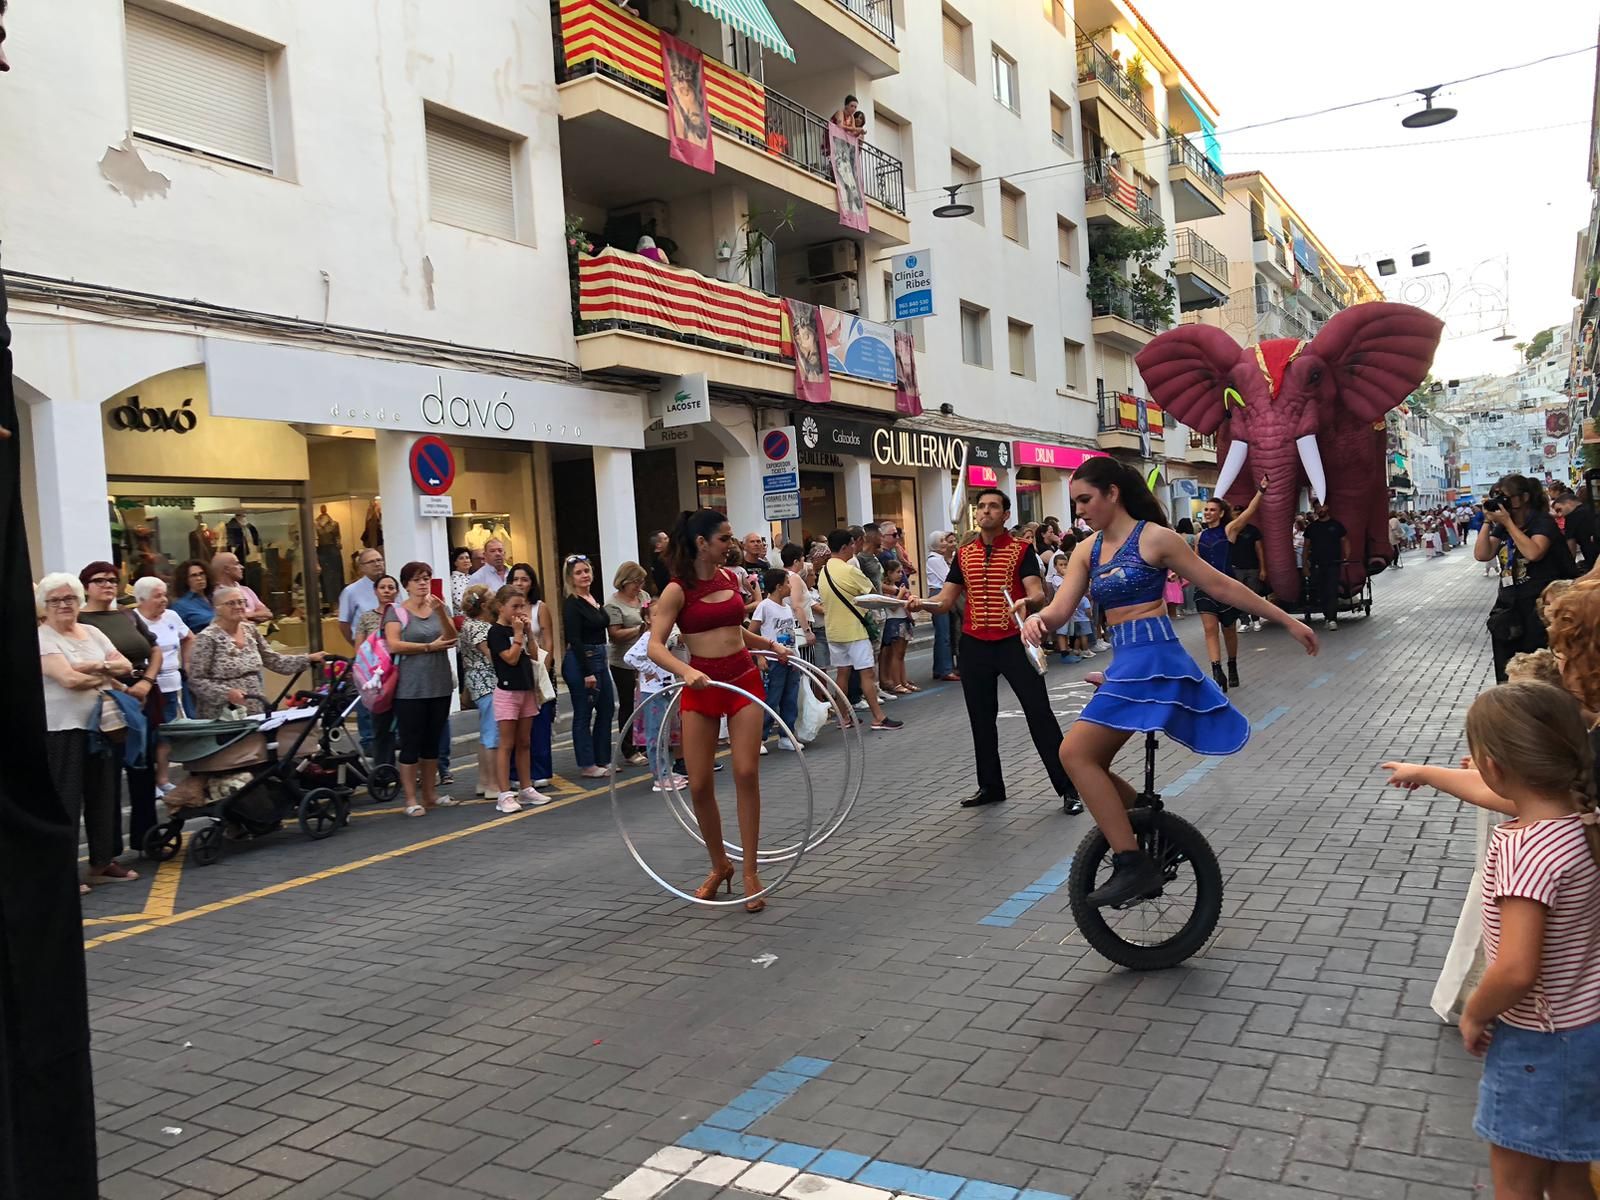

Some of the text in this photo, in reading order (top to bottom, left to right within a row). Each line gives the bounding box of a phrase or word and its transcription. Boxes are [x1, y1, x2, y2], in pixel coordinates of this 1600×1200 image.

[894, 269, 924, 282] Clínica
[905, 278, 931, 289] Ribes
[330, 375, 582, 438] desde davó 1970
[667, 400, 702, 413] LACOSTE
[107, 395, 197, 434] davó
[661, 430, 689, 441] Ribes
[832, 428, 861, 446] Calzados
[873, 428, 964, 470] GUILLERMO
[1035, 447, 1055, 464] DRUNI
